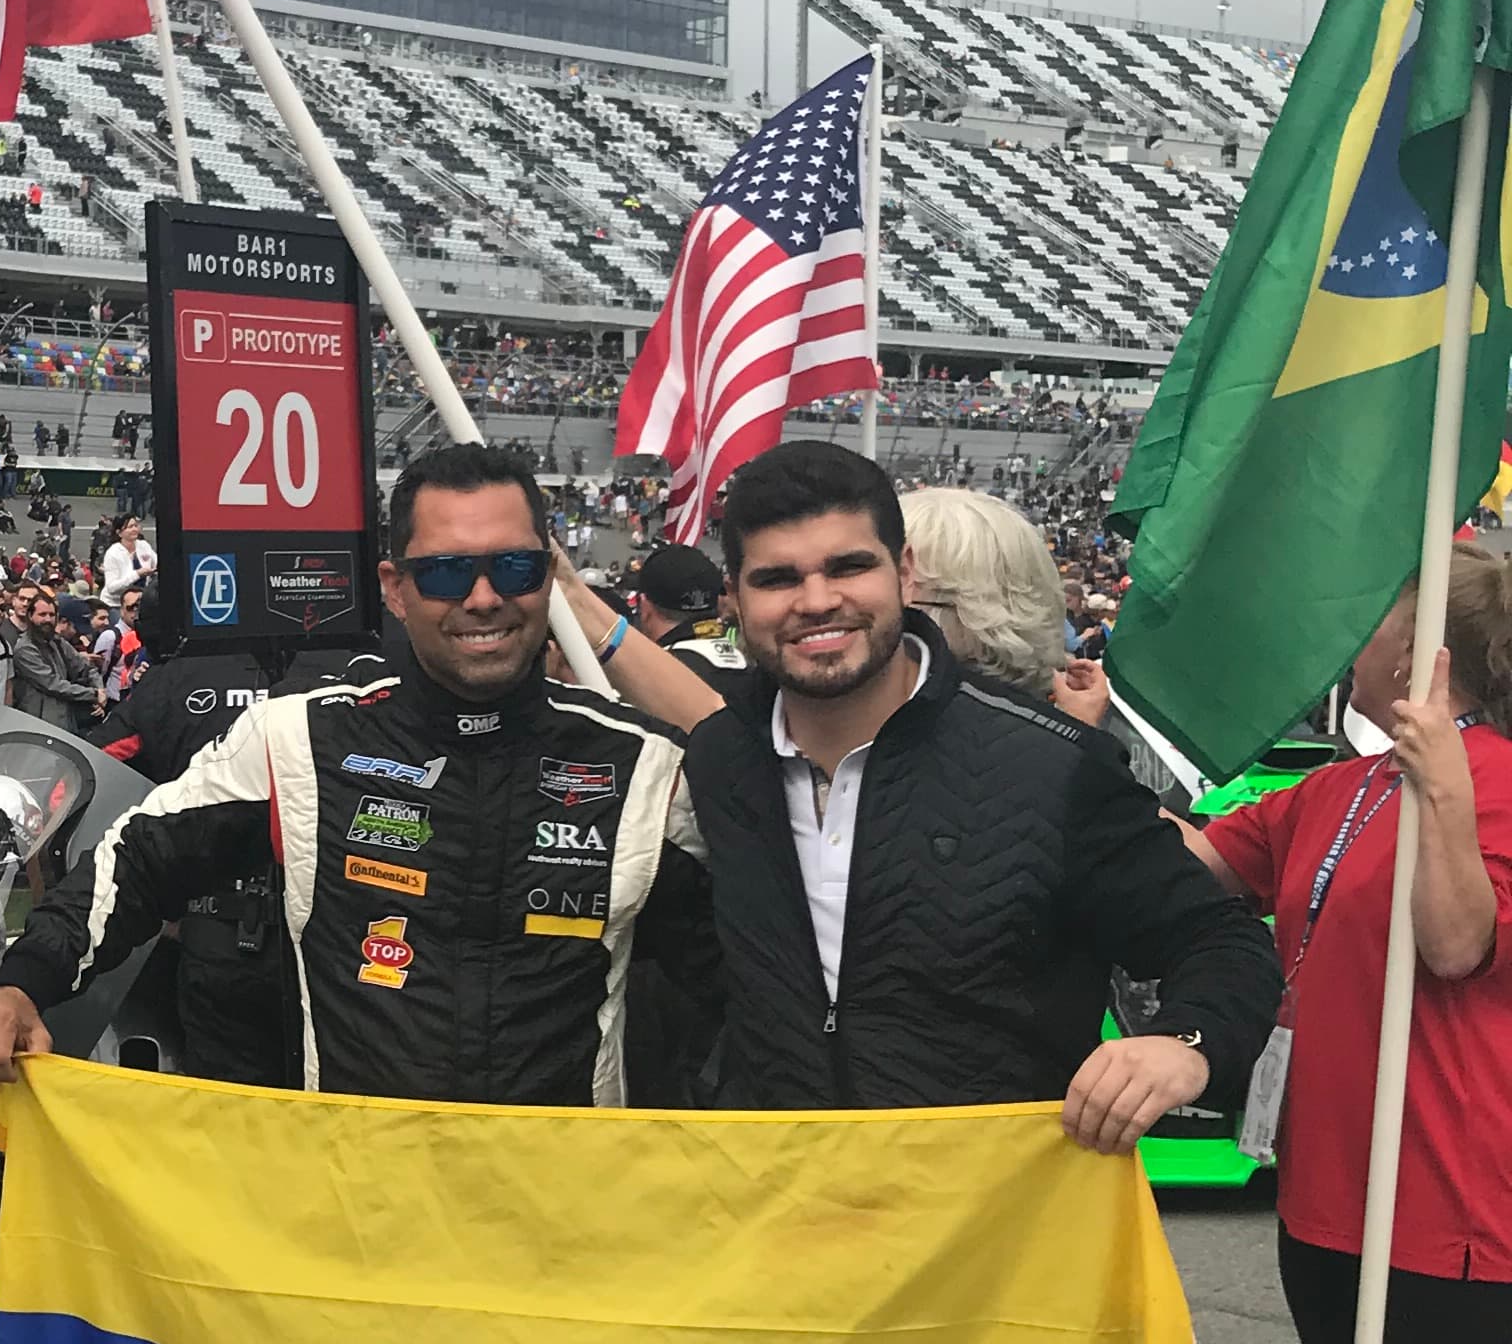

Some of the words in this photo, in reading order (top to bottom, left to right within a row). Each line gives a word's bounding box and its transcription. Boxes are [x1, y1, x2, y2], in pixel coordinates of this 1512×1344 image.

[238, 235, 287, 256] BAR1
[188, 254, 335, 285] MOTORSPORTS
[193, 319, 213, 353] P
[232, 327, 342, 357] PROTOTYPE
[216, 389, 320, 508] 20
[458, 715, 500, 732] OMP
[342, 753, 448, 790] BAR1
[367, 802, 421, 823] PATRÓN
[535, 821, 607, 851] SRA
[349, 862, 410, 886] Continental
[528, 888, 607, 916] ONE
[369, 942, 407, 961] TOP
